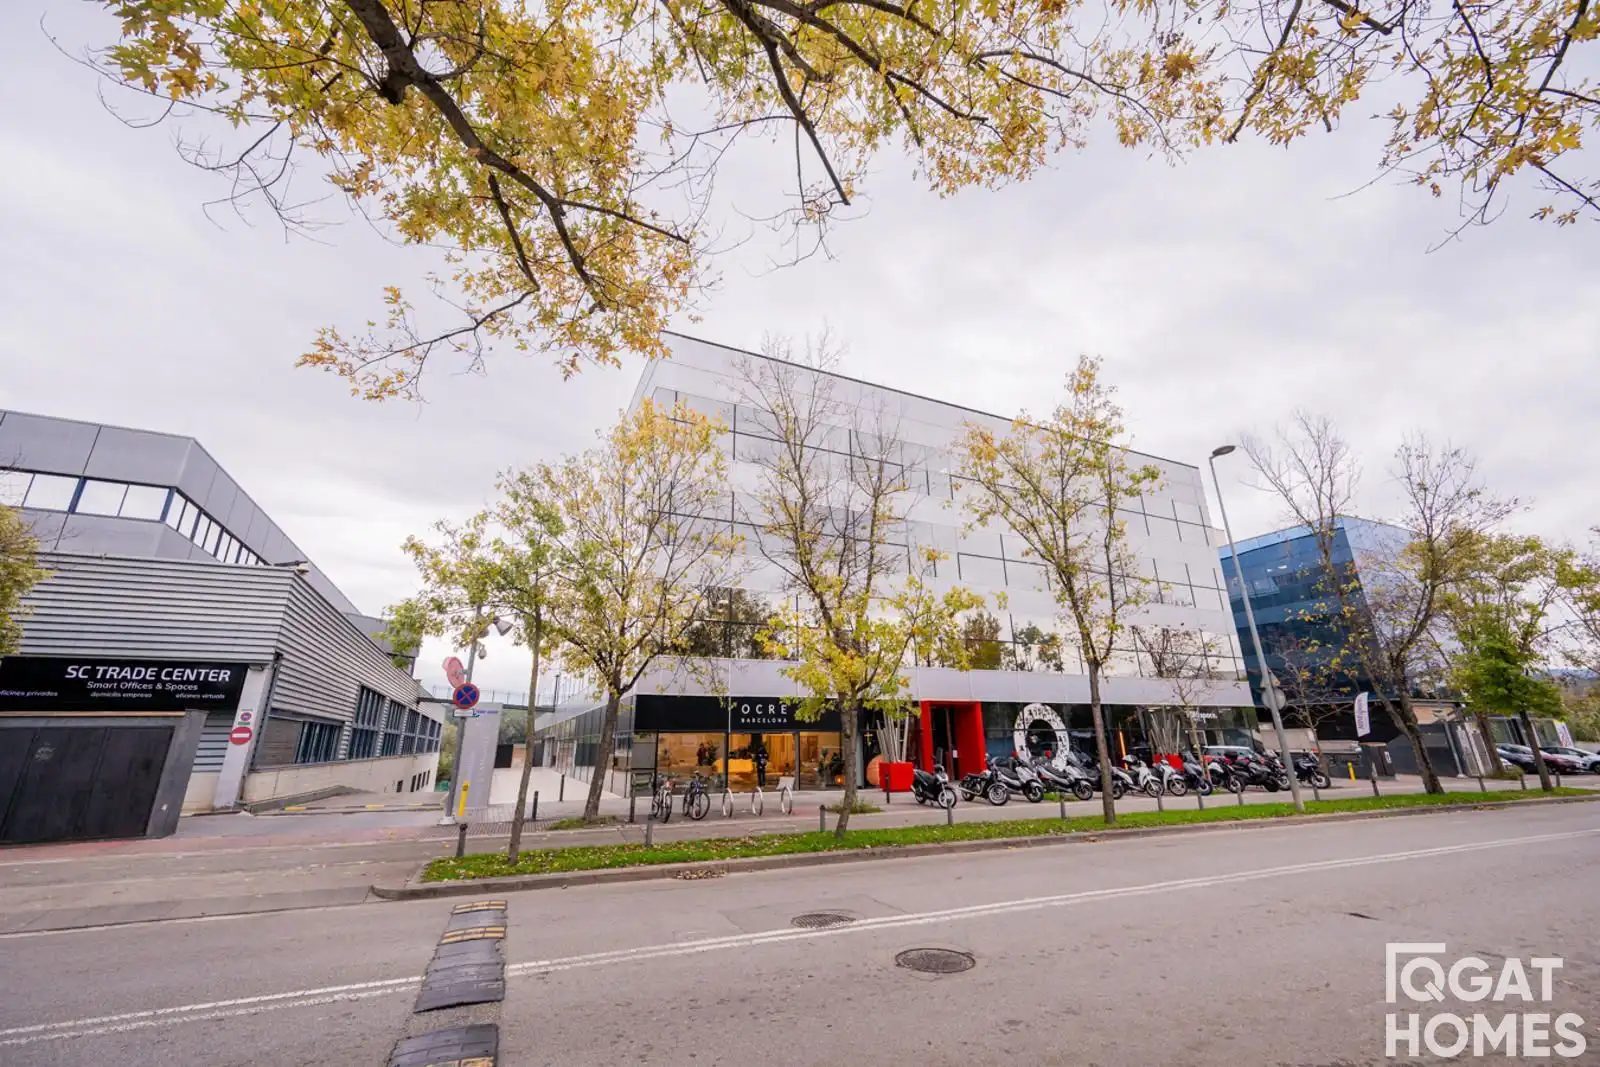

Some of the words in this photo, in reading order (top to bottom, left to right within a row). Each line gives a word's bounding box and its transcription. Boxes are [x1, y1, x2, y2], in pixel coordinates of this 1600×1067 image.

[65, 665, 91, 679] SC
[95, 666, 158, 680] TRADE
[160, 668, 231, 682] CENTER
[86, 681, 117, 689] Smart
[119, 681, 153, 690] Offices
[165, 683, 198, 692] Spaces
[741, 704, 788, 715] OCRE
